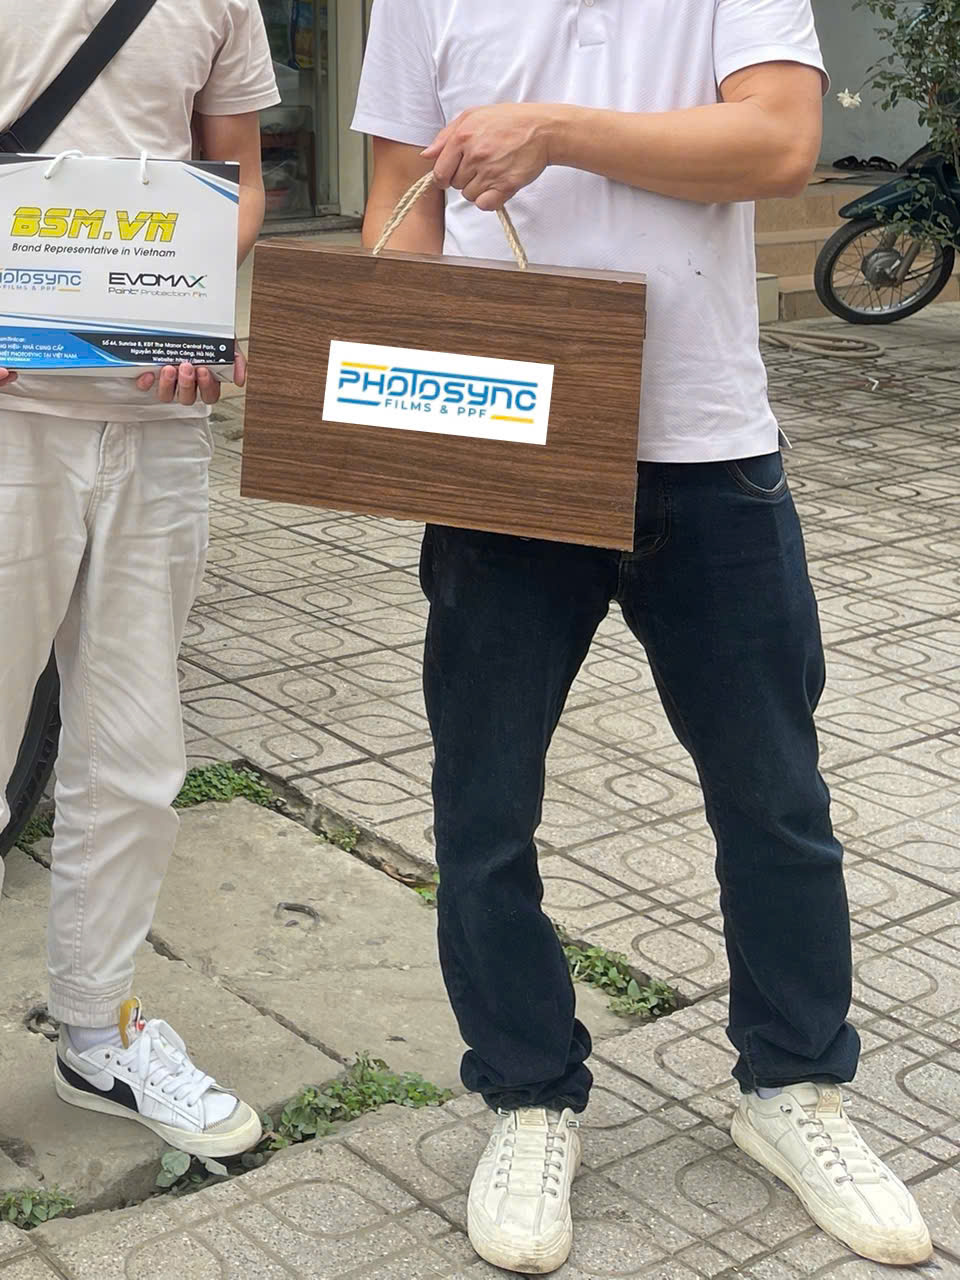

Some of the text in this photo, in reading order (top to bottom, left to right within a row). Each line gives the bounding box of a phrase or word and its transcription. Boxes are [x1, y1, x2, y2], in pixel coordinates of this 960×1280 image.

[9, 206, 180, 243] BSM.VN
[11, 242, 176, 259] Brand Representative in Vietnam
[108, 271, 208, 289] EVOMAX
[384, 398, 488, 420] FILMS & PPF
